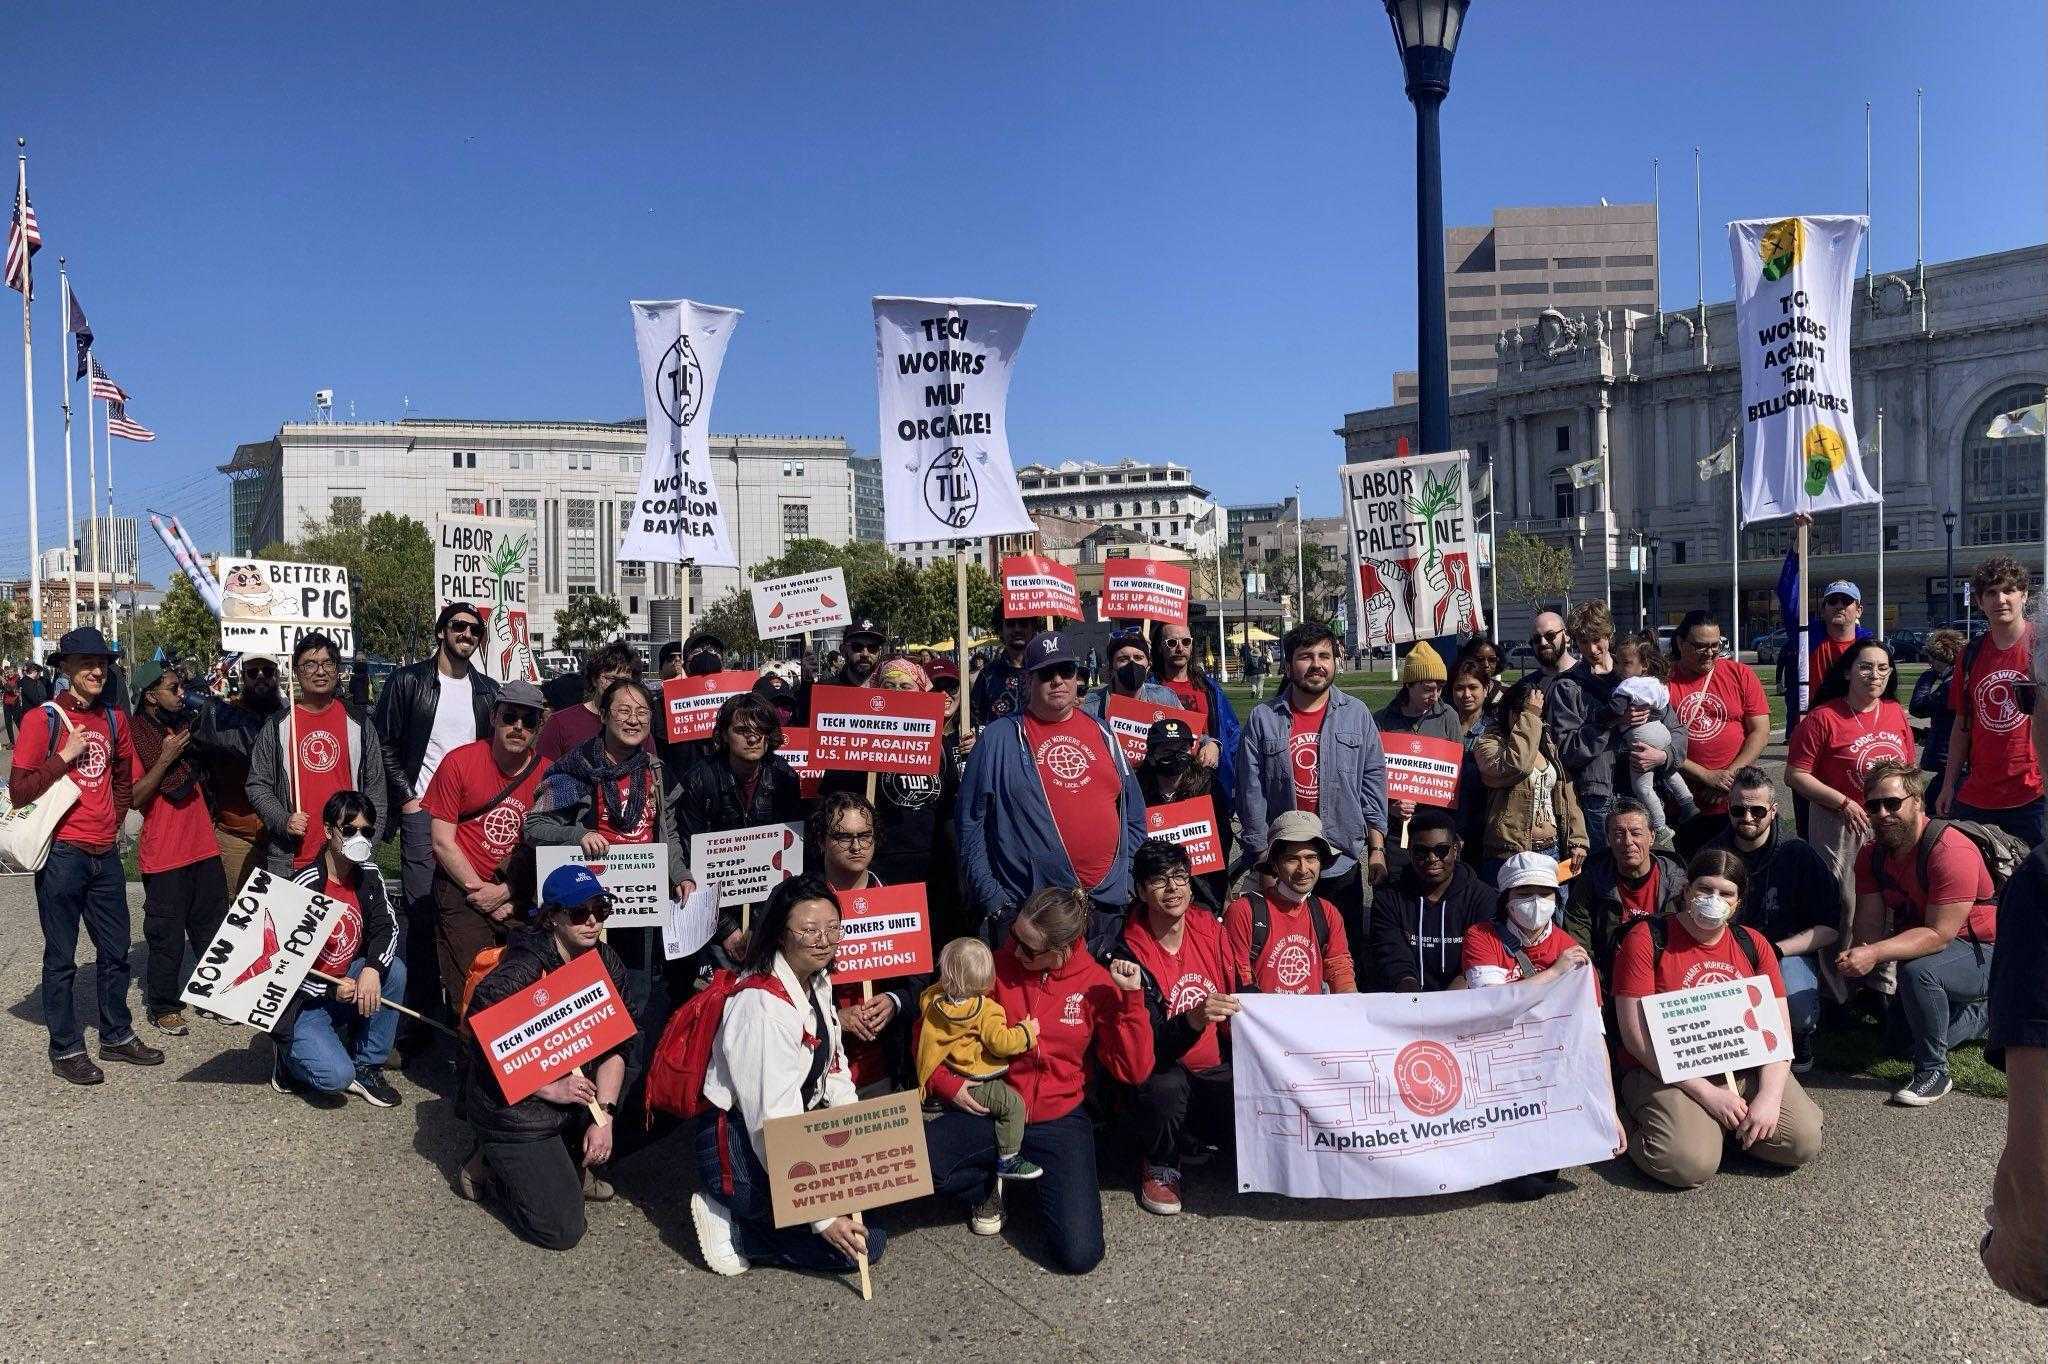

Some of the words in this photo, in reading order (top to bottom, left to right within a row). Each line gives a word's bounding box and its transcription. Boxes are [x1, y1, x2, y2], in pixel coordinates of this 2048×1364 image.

[1349, 468, 1414, 501] LABOR
[1368, 501, 1399, 524] FOR
[442, 524, 493, 553] LABOR
[454, 554, 481, 573] FOR
[269, 565, 331, 584] BETTER
[336, 569, 347, 584] A
[762, 583, 787, 592] TECH
[1010, 579, 1028, 587] TECH
[1112, 580, 1129, 588] TECH
[1131, 580, 1164, 591] WORKERS
[1165, 586, 1183, 596] UNITE
[301, 587, 348, 619] PIG
[1010, 592, 1030, 601] RISE
[1032, 591, 1045, 600] UP
[1110, 593, 1130, 601] RISE
[1131, 593, 1144, 602] UP
[1146, 594, 1183, 609] AGAINST
[786, 608, 821, 620] FREE
[1008, 602, 1027, 611] U.S.
[1107, 603, 1125, 611] U.S.
[1127, 603, 1184, 620] IMPERIALISM!
[260, 627, 269, 635] A
[768, 614, 844, 633] PALESTINE
[280, 625, 351, 653] FAST
[673, 702, 691, 710] TECH
[674, 714, 694, 724] RISE
[696, 712, 711, 720] UP
[822, 717, 846, 728] TECH
[849, 718, 899, 731] WORKERS
[902, 721, 931, 733] UNITE
[1113, 719, 1132, 731] TECH
[673, 726, 692, 735] U.S.
[820, 735, 846, 747] RISE
[850, 737, 869, 748] UP
[871, 738, 931, 752] AGAINST
[1128, 740, 1147, 751] STO
[1297, 734, 1319, 745] AW
[815, 748, 840, 760] U.S.
[844, 751, 932, 766] IMPERIALISM!
[1394, 757, 1432, 770] WORKERS
[1433, 763, 1455, 774] UNITE
[900, 775, 929, 790] TWC
[1394, 771, 1409, 781] UP
[1411, 774, 1454, 789] AGAINST
[706, 837, 732, 846] TECH
[734, 831, 779, 842] WORKERS
[1182, 824, 1208, 839] UNITE
[706, 844, 746, 855] DEMAND
[1185, 840, 1211, 855] INST
[610, 862, 656, 870] DEMAND
[706, 858, 746, 869] STOP
[706, 864, 771, 880] BUILDING
[737, 875, 767, 885] WAR
[613, 884, 657, 893] TECH
[721, 884, 768, 898] ACHINE
[888, 917, 916, 930] UNITE
[187, 938, 234, 999] ROW
[226, 869, 273, 931] ROW
[870, 940, 894, 953] THE
[248, 981, 288, 1029] FIGHT
[274, 958, 290, 976] THE
[283, 894, 334, 958] POWER
[837, 951, 917, 972] ORTATIONS!
[1659, 997, 1689, 1010] TECH
[1689, 988, 1743, 1002] WORKERS
[496, 1032, 523, 1054] TECH
[523, 1004, 573, 1037] WORKERS
[574, 986, 605, 1010] UNITE
[1661, 1004, 1707, 1020] DEMAND
[1666, 1020, 1711, 1035] STOP
[1669, 1025, 1745, 1046] BUILDING
[502, 1045, 542, 1076] BUILD
[543, 1004, 617, 1051] COLLECTIVE
[1673, 1045, 1707, 1059] THE
[1707, 1037, 1745, 1051] WAR
[539, 1035, 593, 1073] POWER!
[1676, 1048, 1750, 1071] MACHINE
[803, 1120, 840, 1134] TECH
[842, 1104, 907, 1126] WORKERS
[854, 1117, 910, 1136] DEMAND
[1314, 1128, 1409, 1151] Alphabet
[818, 1157, 859, 1174] END
[861, 1144, 915, 1163] TECH
[793, 1159, 917, 1193] CONTRACTS
[791, 1190, 844, 1209] WITH
[848, 1174, 920, 1198] ISRAEL
